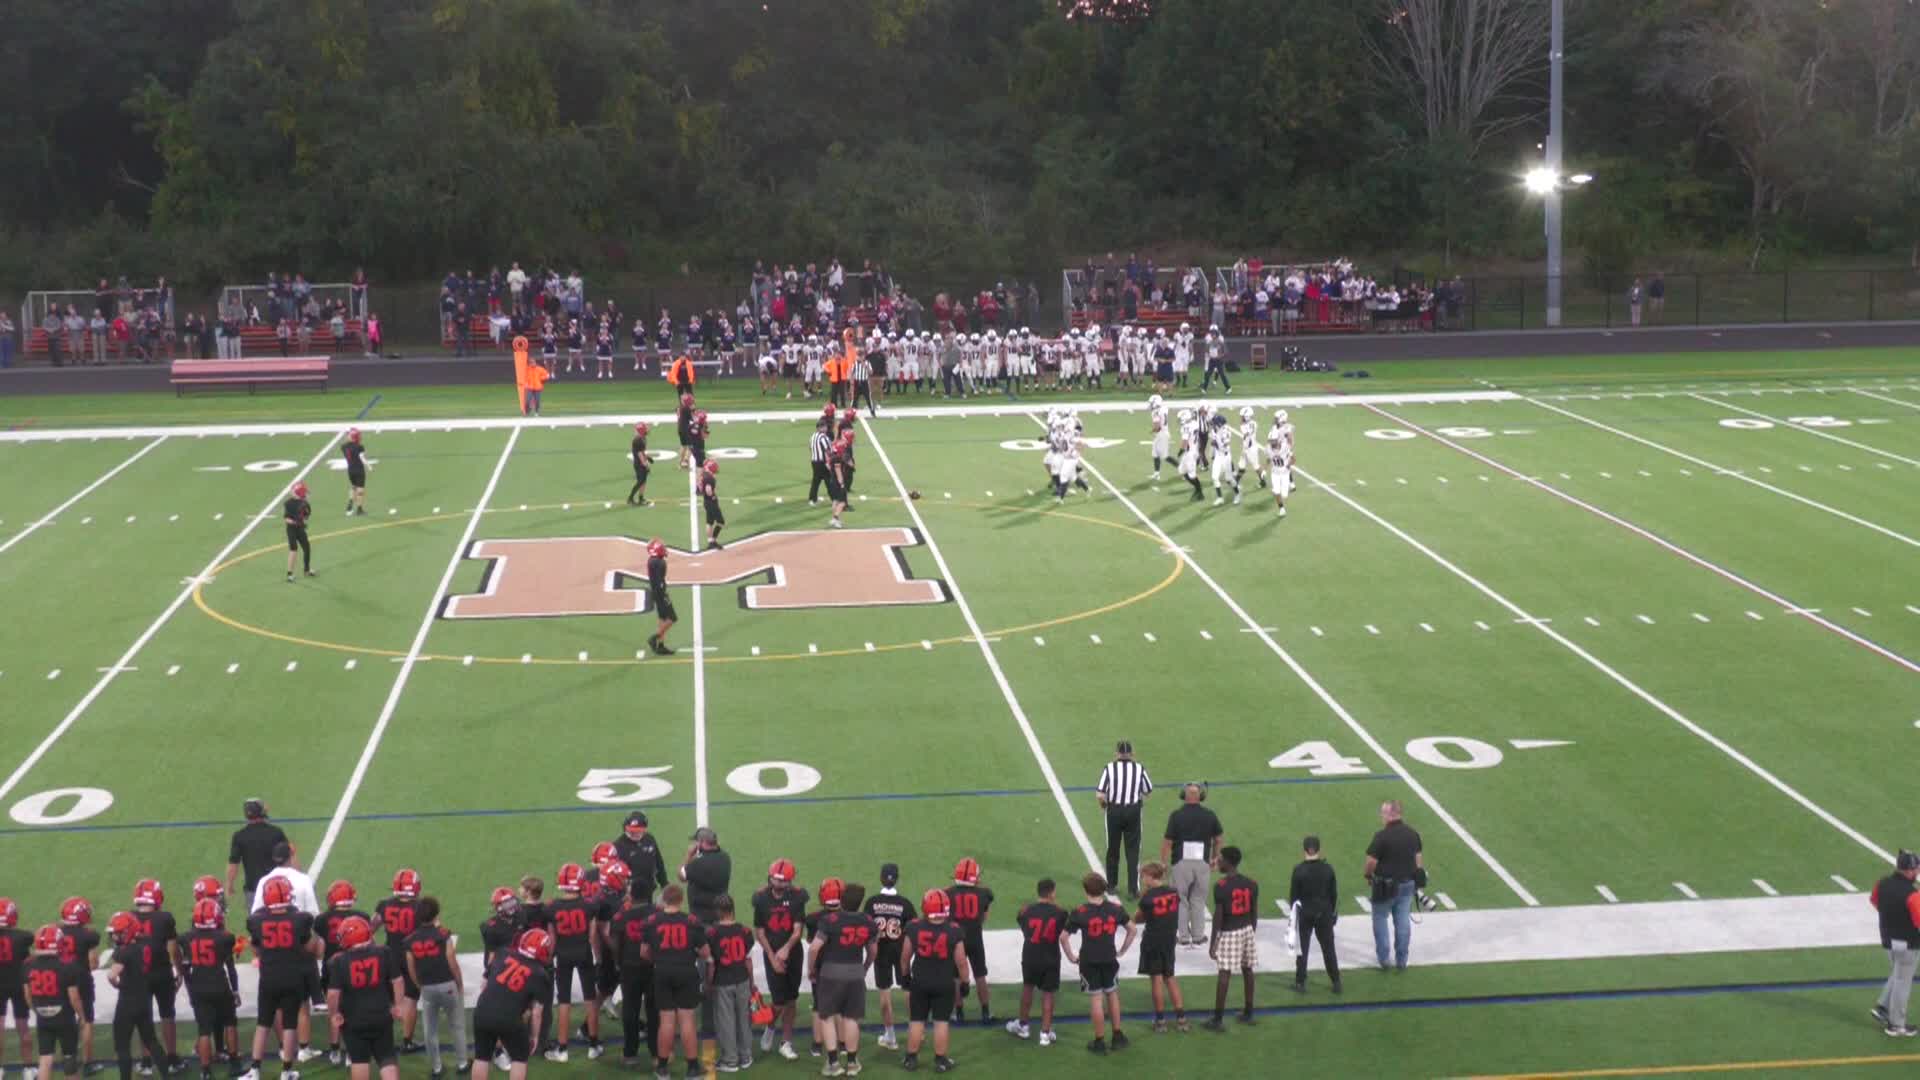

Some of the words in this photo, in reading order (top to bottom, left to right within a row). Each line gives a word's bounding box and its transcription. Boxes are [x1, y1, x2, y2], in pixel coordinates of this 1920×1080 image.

[384, 905, 416, 935] 50
[955, 892, 979, 919] 10
[555, 908, 587, 937] 20
[657, 922, 689, 950] 70
[1027, 917, 1057, 944] 74
[191, 937, 218, 966] 15
[719, 935, 747, 966] 30
[916, 930, 948, 960] 54
[350, 955, 381, 989] 67
[496, 956, 532, 993] 76
